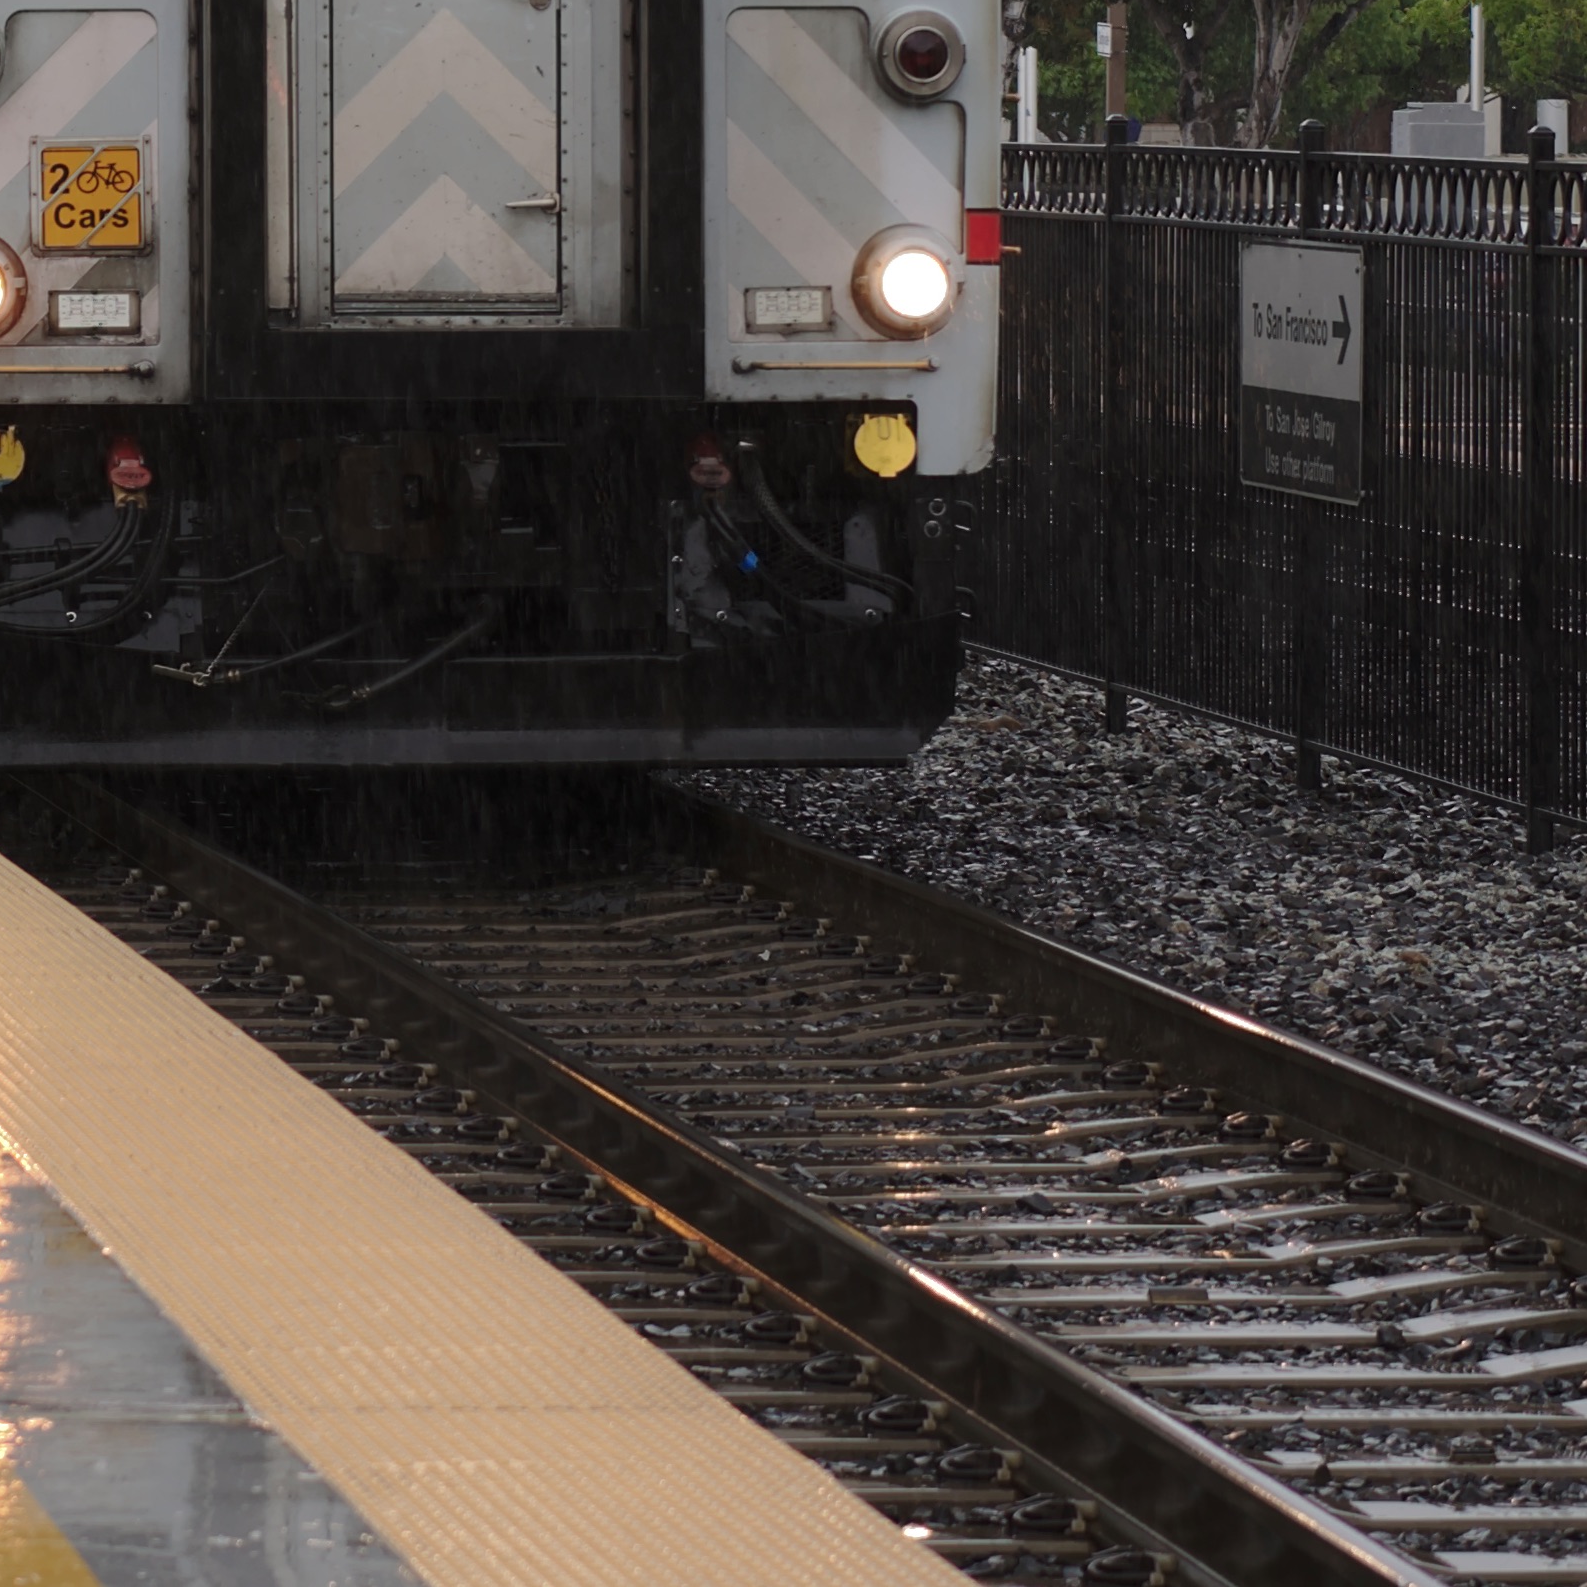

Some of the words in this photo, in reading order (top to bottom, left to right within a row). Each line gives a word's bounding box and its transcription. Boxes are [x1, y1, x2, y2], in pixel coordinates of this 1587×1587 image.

[49, 164, 70, 194] 2
[53, 202, 129, 229] Cars
[1252, 303, 1263, 338] To
[1266, 304, 1283, 341] San
[1285, 307, 1328, 346] Francisco
[1265, 404, 1274, 432] To
[1276, 405, 1290, 434] San
[1265, 446, 1279, 475] Use
[1282, 450, 1301, 478] other
[1302, 453, 1334, 485] platform
